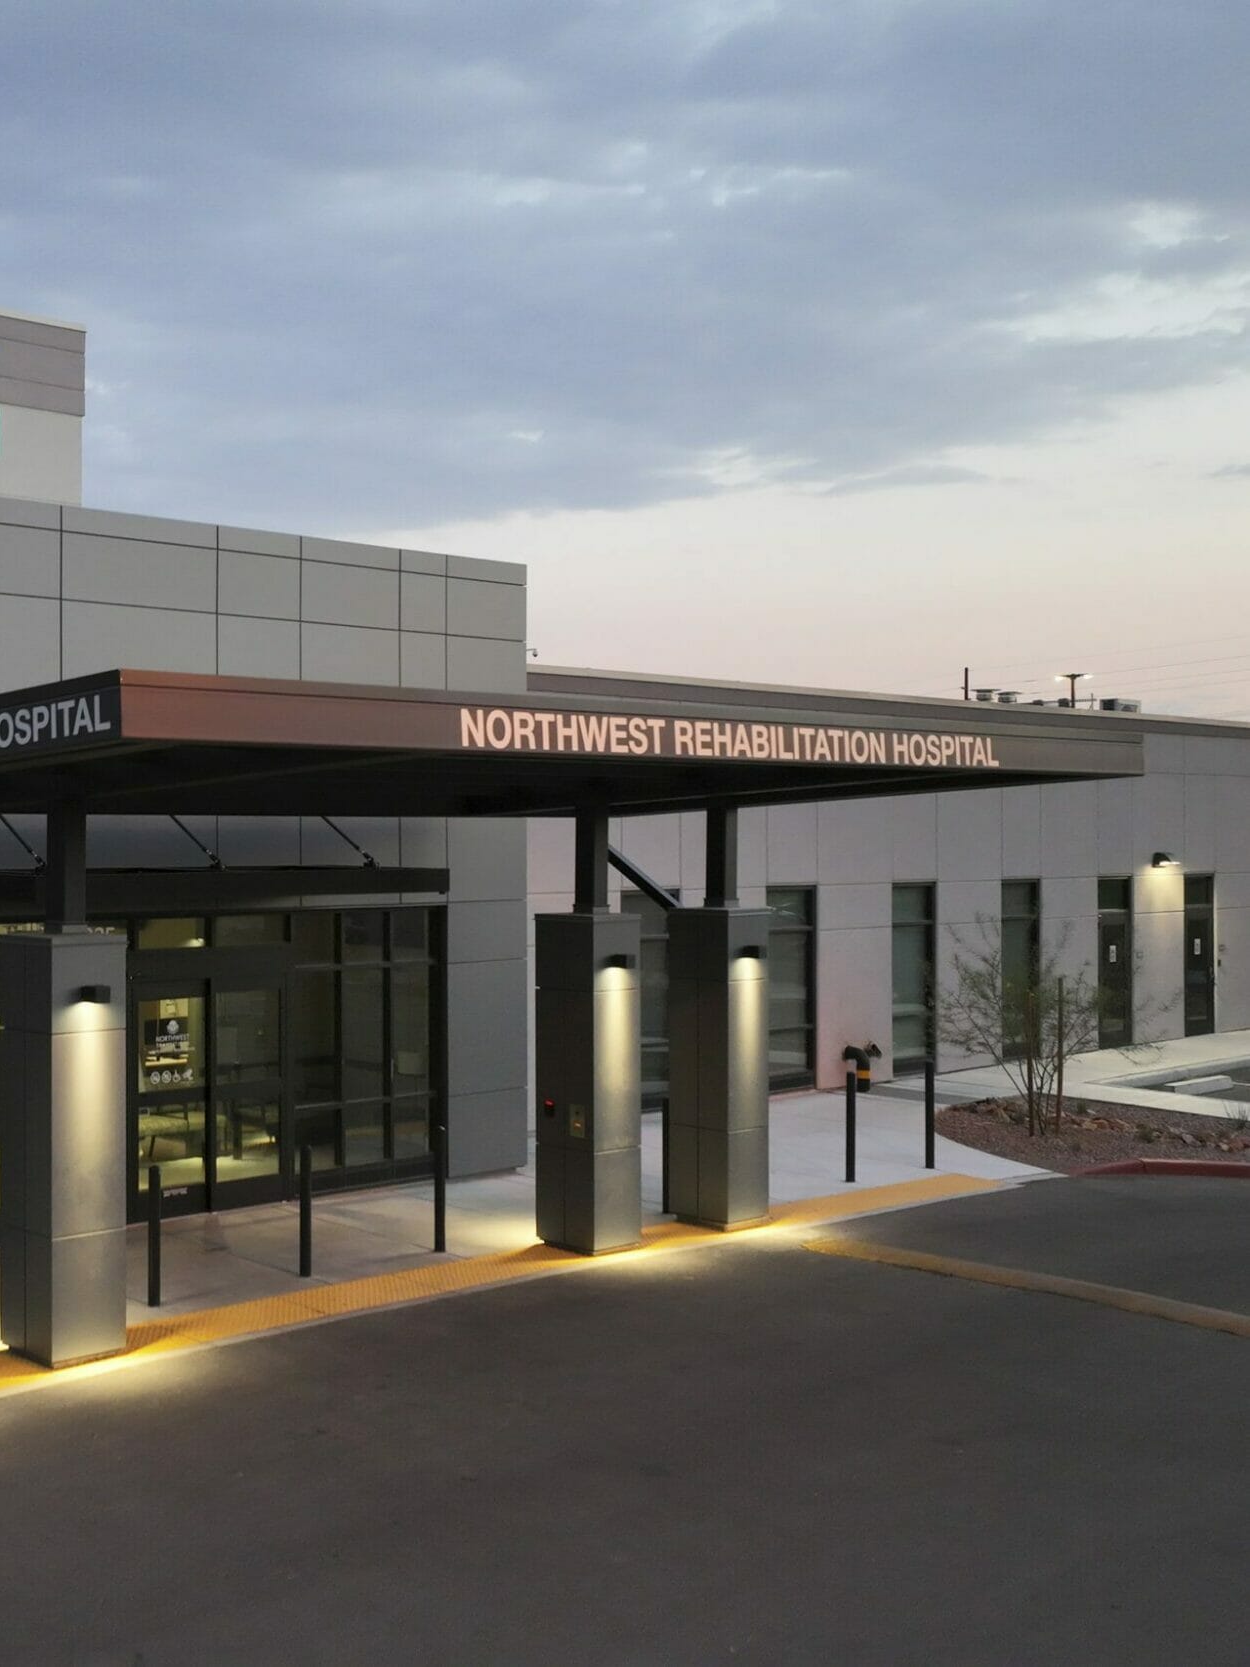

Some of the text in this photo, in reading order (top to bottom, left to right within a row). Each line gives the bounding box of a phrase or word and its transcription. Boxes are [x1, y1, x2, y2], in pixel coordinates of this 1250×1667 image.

[460, 708, 999, 768] NORTHWEST REHABILITATION HOSPITAL
